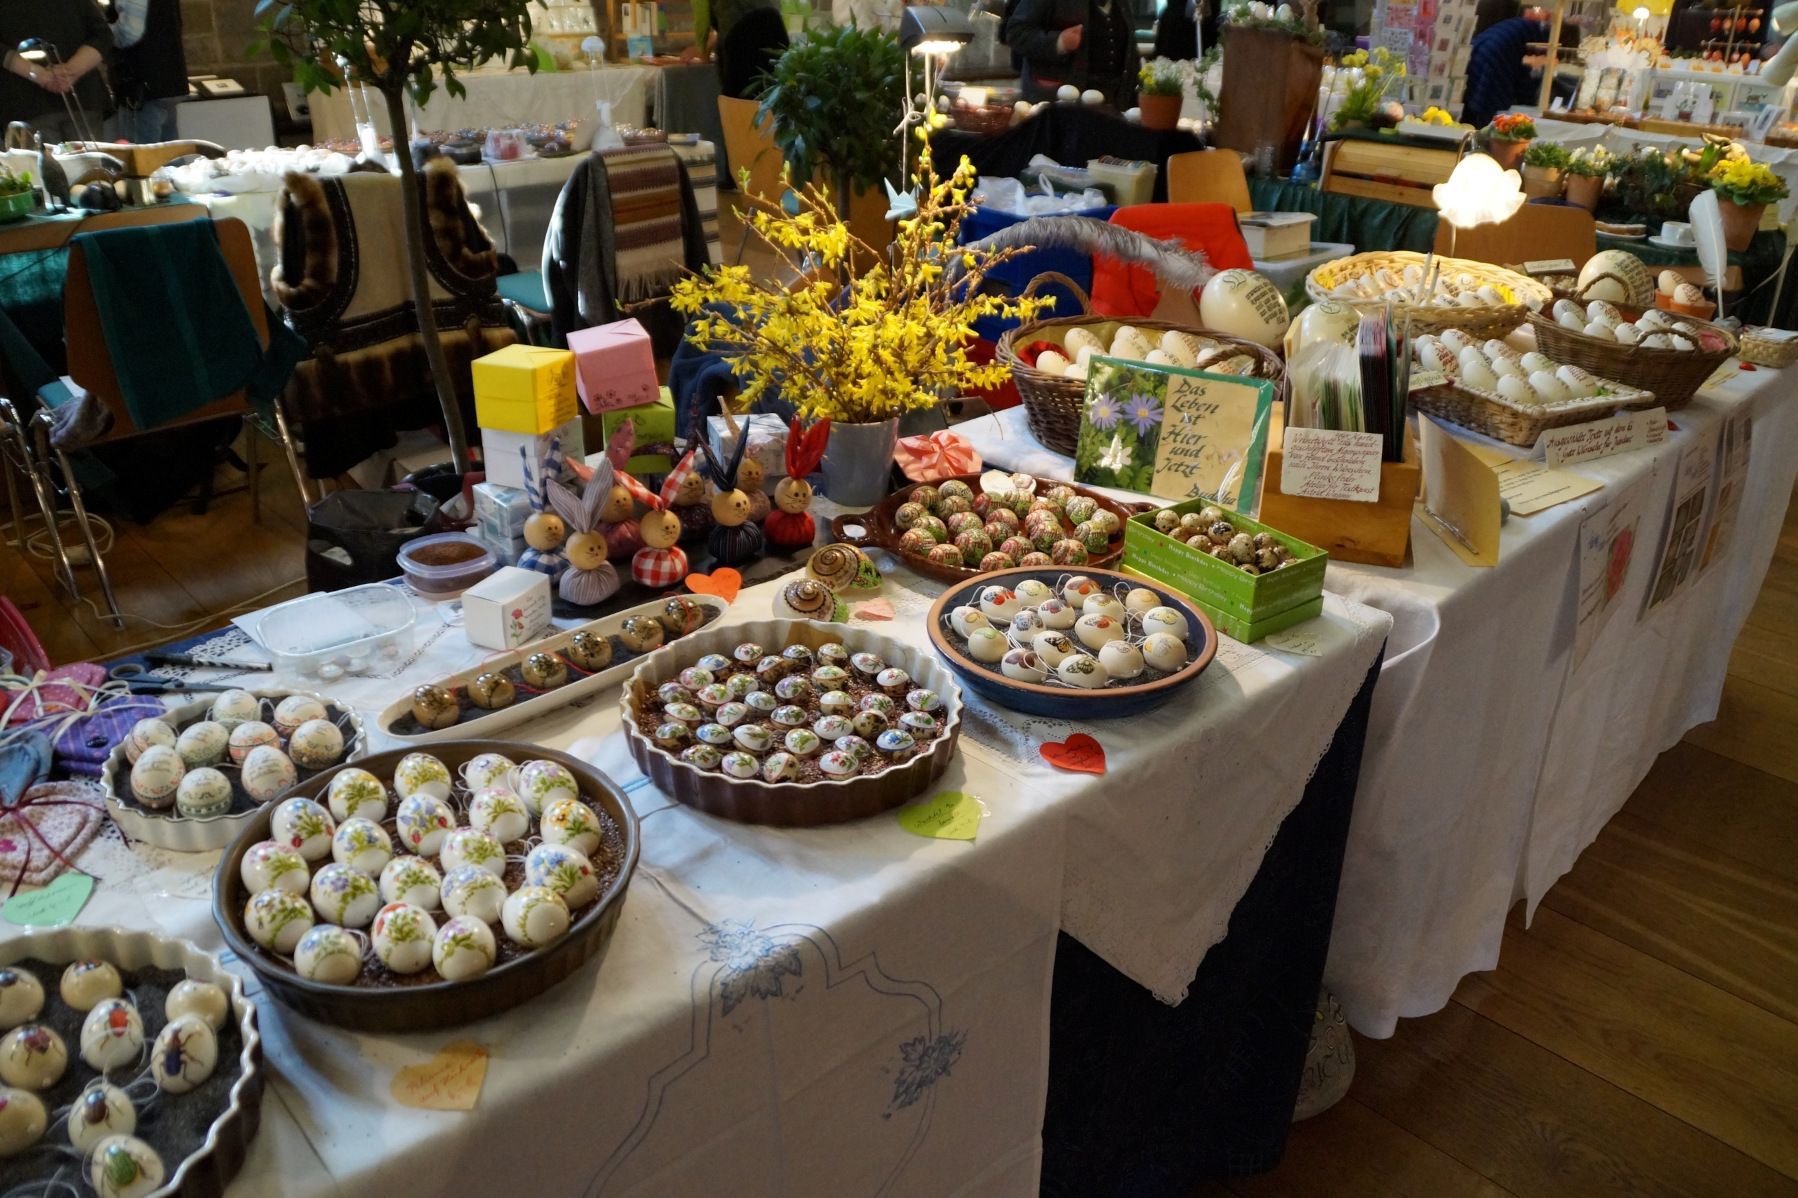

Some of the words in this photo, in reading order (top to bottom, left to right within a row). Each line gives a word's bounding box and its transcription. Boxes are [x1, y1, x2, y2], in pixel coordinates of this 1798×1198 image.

[1173, 378, 1207, 396] Das
[1171, 394, 1220, 414] Leben
[1179, 411, 1206, 426] ist
[1162, 423, 1209, 446] Hier
[1169, 445, 1207, 458] und
[1155, 457, 1201, 478] Jetzt
